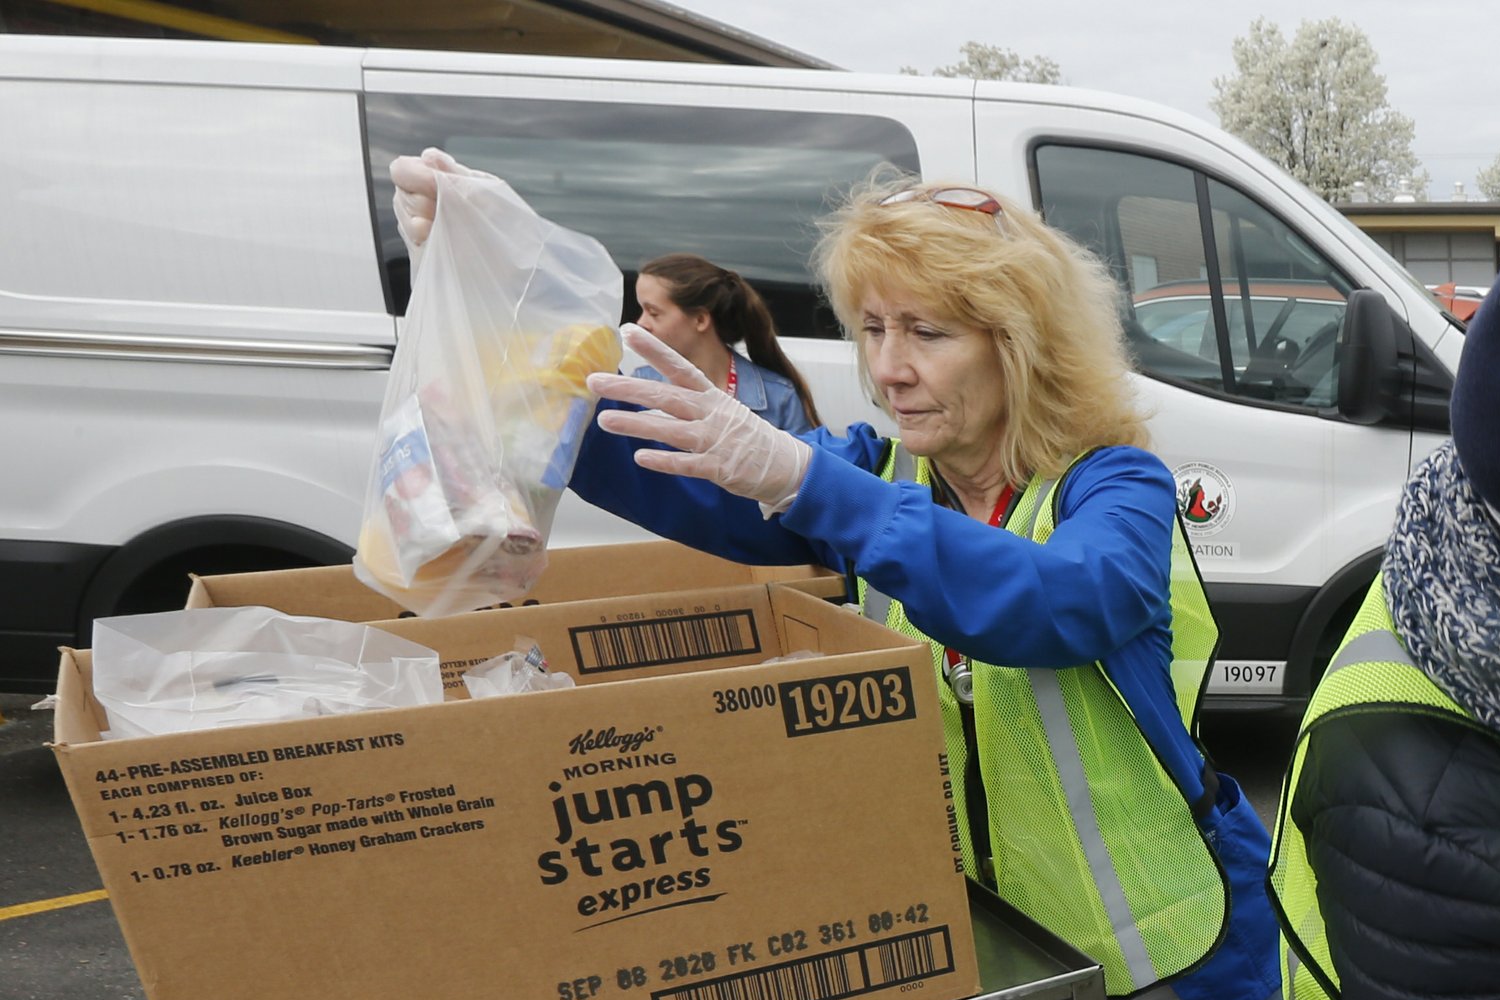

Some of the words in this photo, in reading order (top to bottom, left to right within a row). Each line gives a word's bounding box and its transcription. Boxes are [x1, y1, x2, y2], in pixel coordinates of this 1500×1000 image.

[1224, 665, 1277, 683] 19097
[713, 683, 777, 714] 38000
[788, 673, 907, 731] 19203
[96, 750, 269, 783] 44-PRE-ASSEMBLED
[273, 738, 364, 761] BREAKFAST
[369, 733, 405, 749] KITS
[563, 752, 677, 781] MORNING
[100, 785, 142, 801] EACH
[147, 774, 235, 795] COMPRISED
[239, 771, 264, 783] OF:
[133, 804, 171, 820] 4.23
[175, 801, 195, 814] fl.
[200, 800, 225, 811] oz.
[235, 790, 278, 807] Juice
[282, 787, 312, 799] Box
[548, 773, 713, 846] jump
[139, 824, 178, 841] 1.76
[183, 823, 208, 835] oz.
[399, 784, 456, 803] Frosted
[222, 830, 273, 847] Brown
[277, 822, 321, 839] Sugar
[326, 817, 368, 832] made
[371, 810, 405, 825] with
[407, 802, 453, 819] Whole
[456, 797, 495, 812] Grain
[153, 863, 192, 880] 0.78
[196, 861, 221, 873] oz.
[308, 839, 356, 856] Honey
[360, 829, 417, 848] Graham
[420, 819, 485, 838] Crackers
[577, 867, 711, 917] express
[658, 951, 717, 982] 2020
[727, 941, 756, 967] FK
[819, 918, 856, 946] 361
[900, 981, 924, 993] 0000
